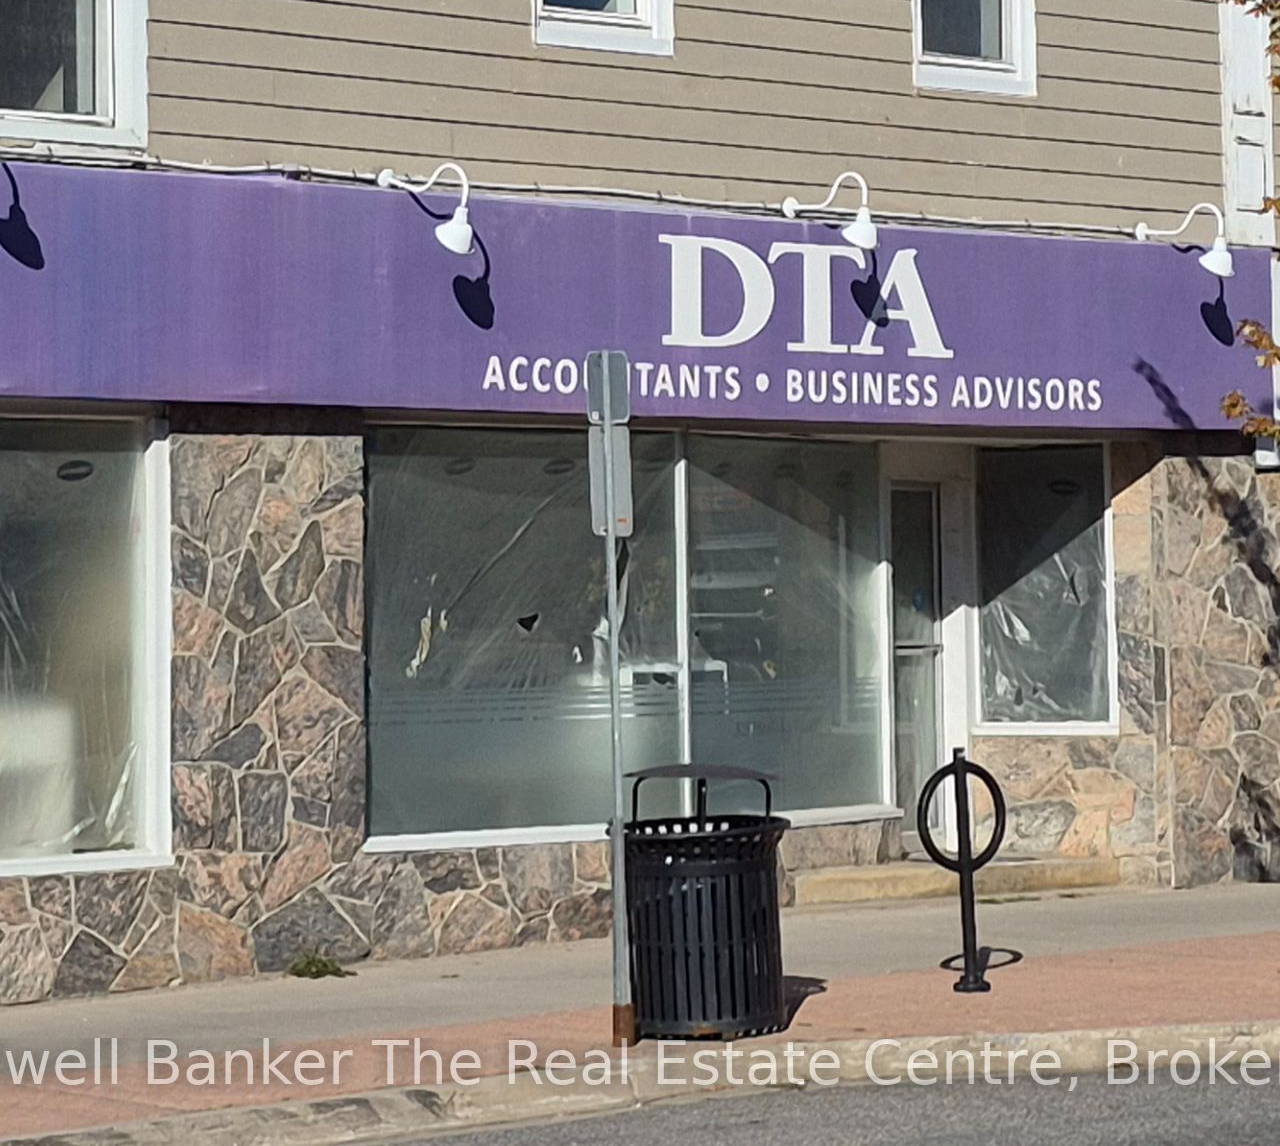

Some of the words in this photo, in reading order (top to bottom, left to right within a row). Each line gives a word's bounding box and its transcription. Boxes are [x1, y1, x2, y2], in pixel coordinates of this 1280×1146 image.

[658, 233, 954, 359] DTA
[481, 354, 742, 401] ACCOTANTS
[786, 368, 938, 408] BUSINESS
[950, 375, 1103, 411] ADVISORS
